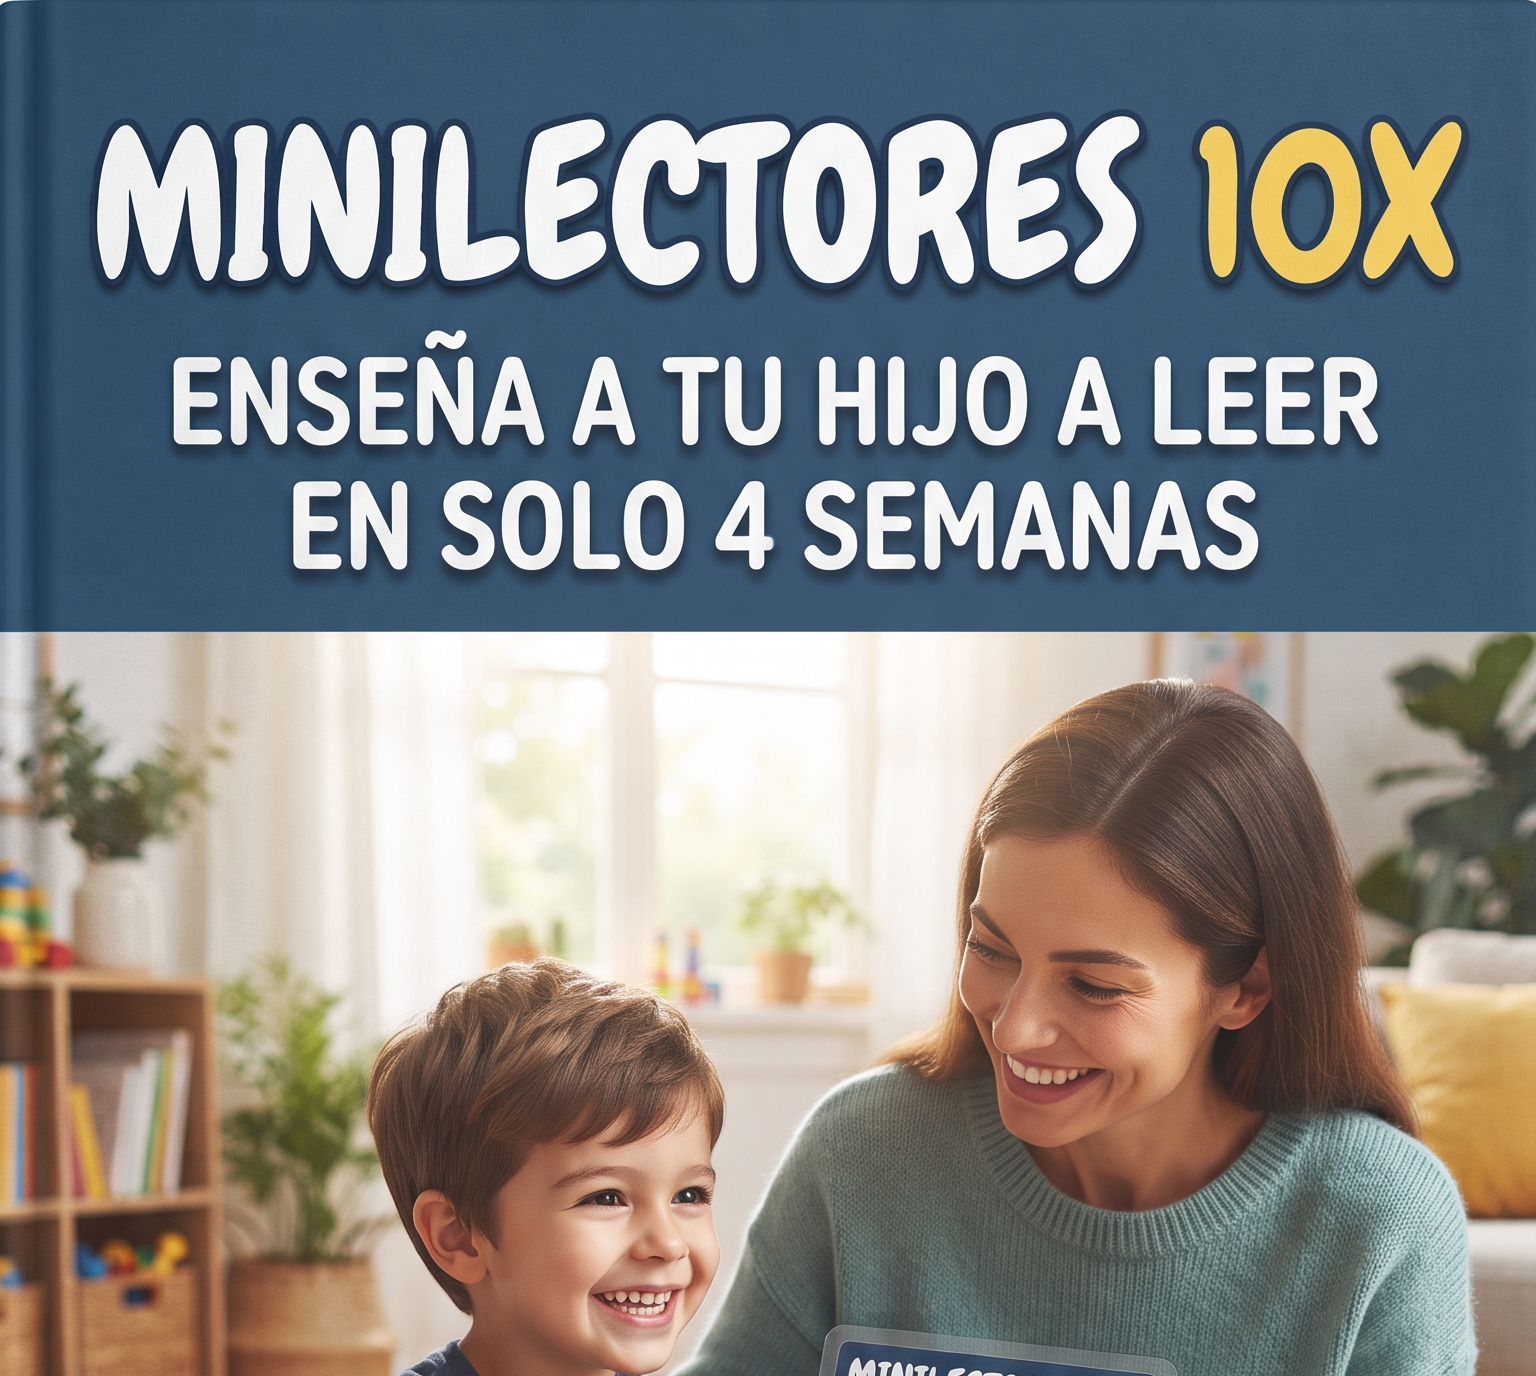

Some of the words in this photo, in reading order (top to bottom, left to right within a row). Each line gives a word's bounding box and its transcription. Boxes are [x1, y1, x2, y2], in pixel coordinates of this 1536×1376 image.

[97, 114, 1140, 286] MINILECTORES
[1200, 120, 1462, 284] 10X
[174, 330, 544, 446] ENSEÑA
[572, 356, 636, 446] A
[662, 356, 782, 446] TU
[818, 356, 1028, 446] HIJO
[1057, 356, 1122, 446] A
[1154, 356, 1379, 446] LEER
[292, 480, 408, 571] EN
[441, 480, 685, 571] SOLO
[714, 480, 774, 570] 4
[803, 480, 1259, 571] SEMANAS
